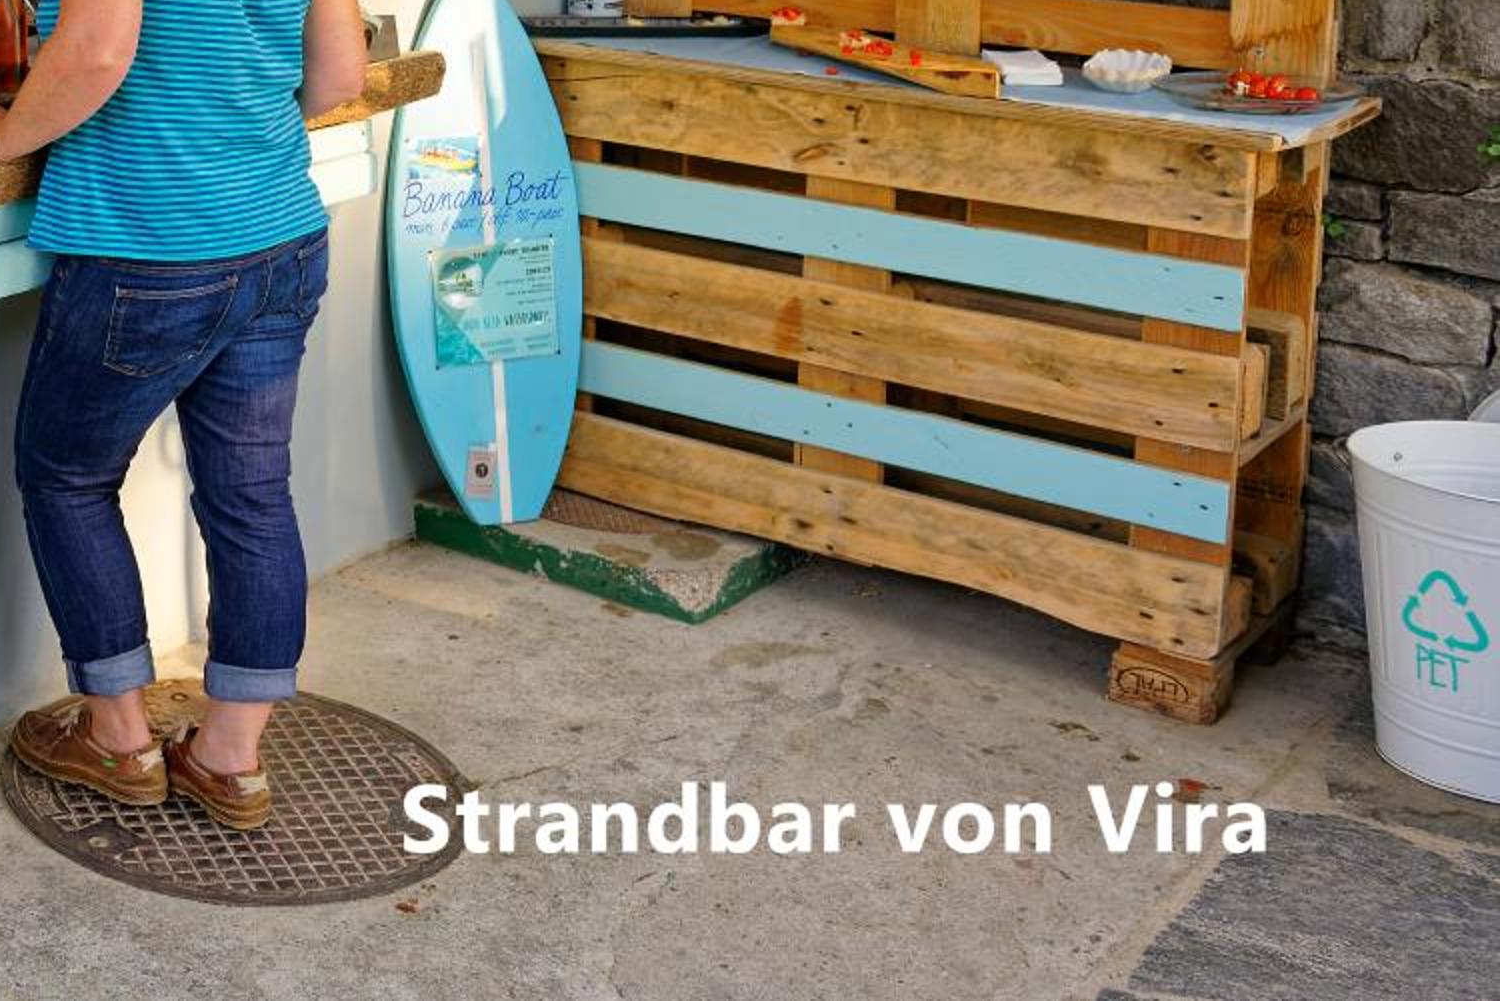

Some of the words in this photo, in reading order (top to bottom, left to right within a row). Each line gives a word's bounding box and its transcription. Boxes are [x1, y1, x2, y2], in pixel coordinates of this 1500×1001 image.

[403, 180, 497, 218] Banana
[505, 169, 573, 206] Boat
[1415, 642, 1471, 693] PET
